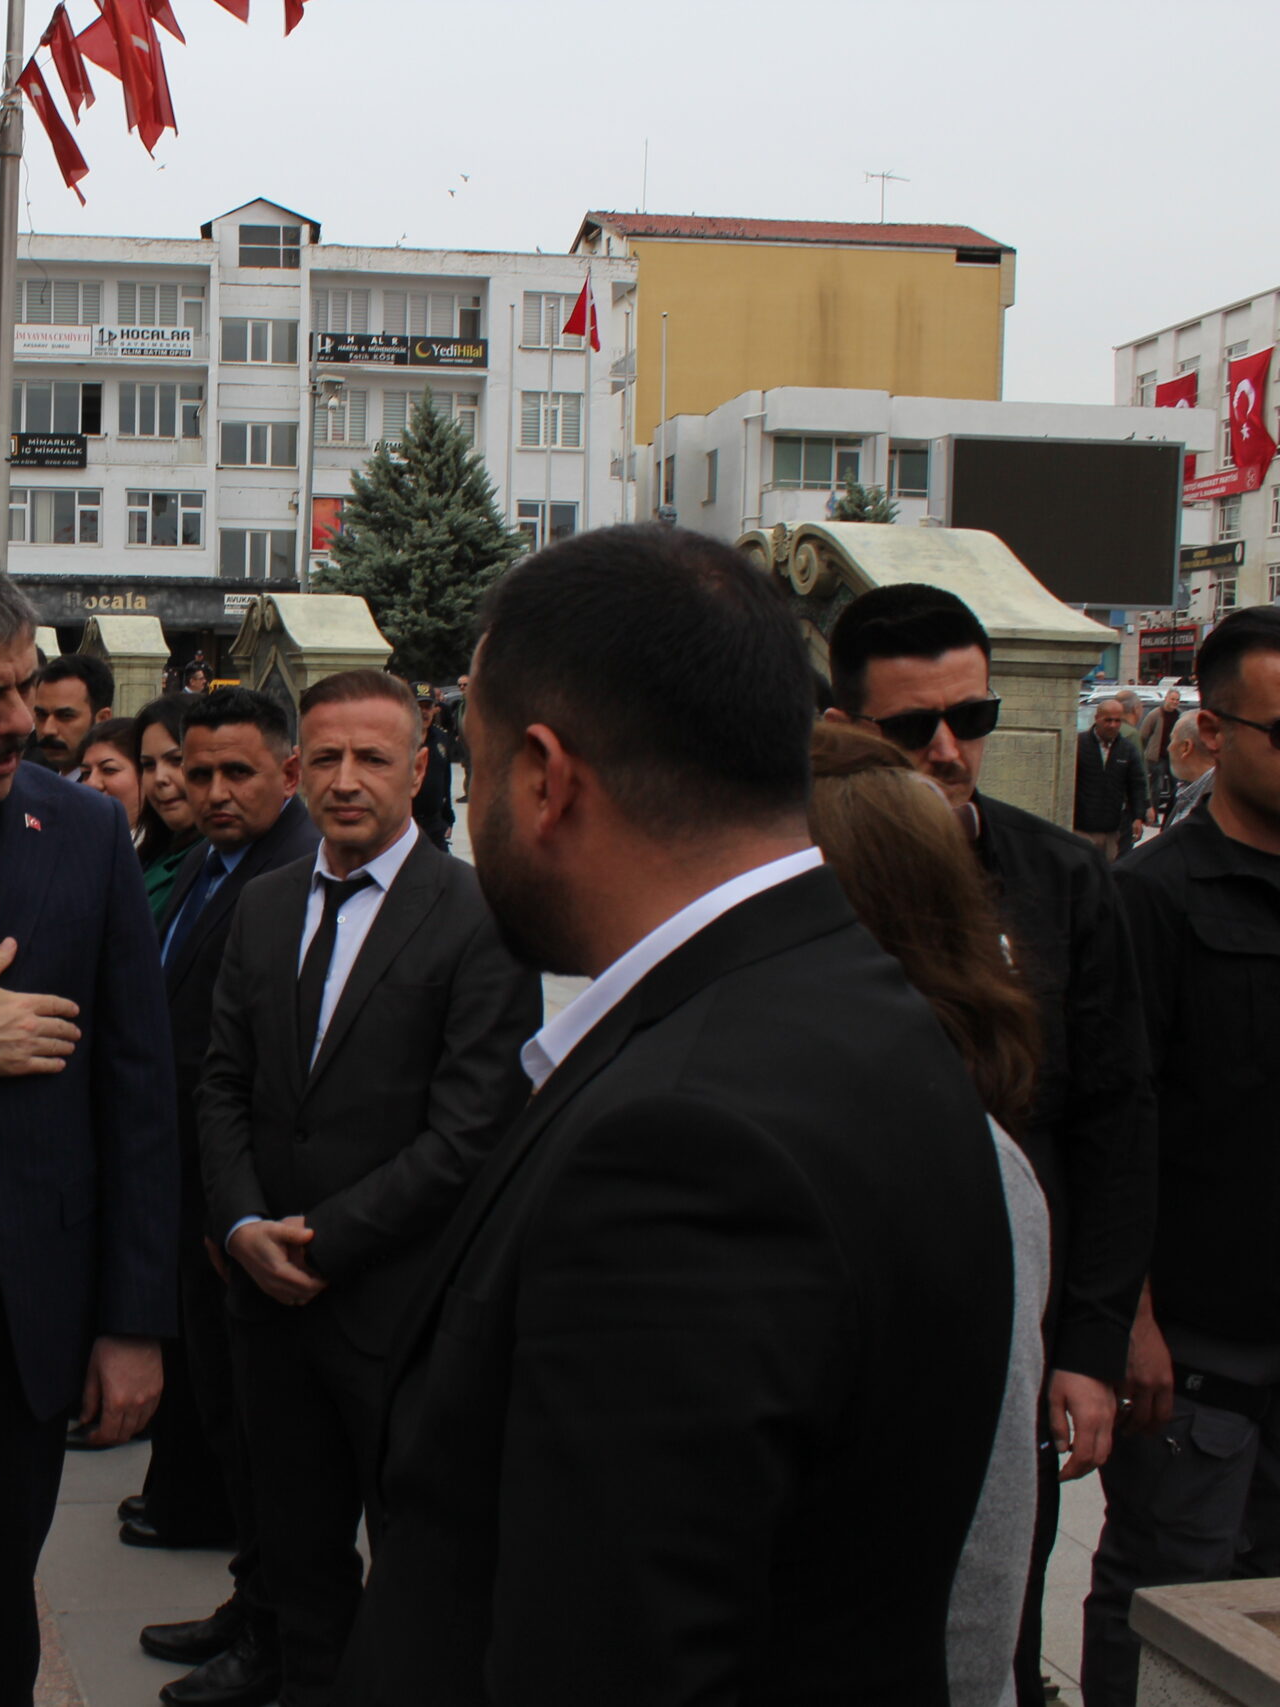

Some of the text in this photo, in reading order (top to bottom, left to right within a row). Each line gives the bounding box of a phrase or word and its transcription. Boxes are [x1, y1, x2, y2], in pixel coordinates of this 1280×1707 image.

[120, 328, 190, 341] HOCALAR
[432, 343, 483, 358] YediHilal
[349, 352, 370, 360] Fatih
[28, 437, 77, 446] MİMARLIK
[34, 446, 83, 455] MİMARLIK
